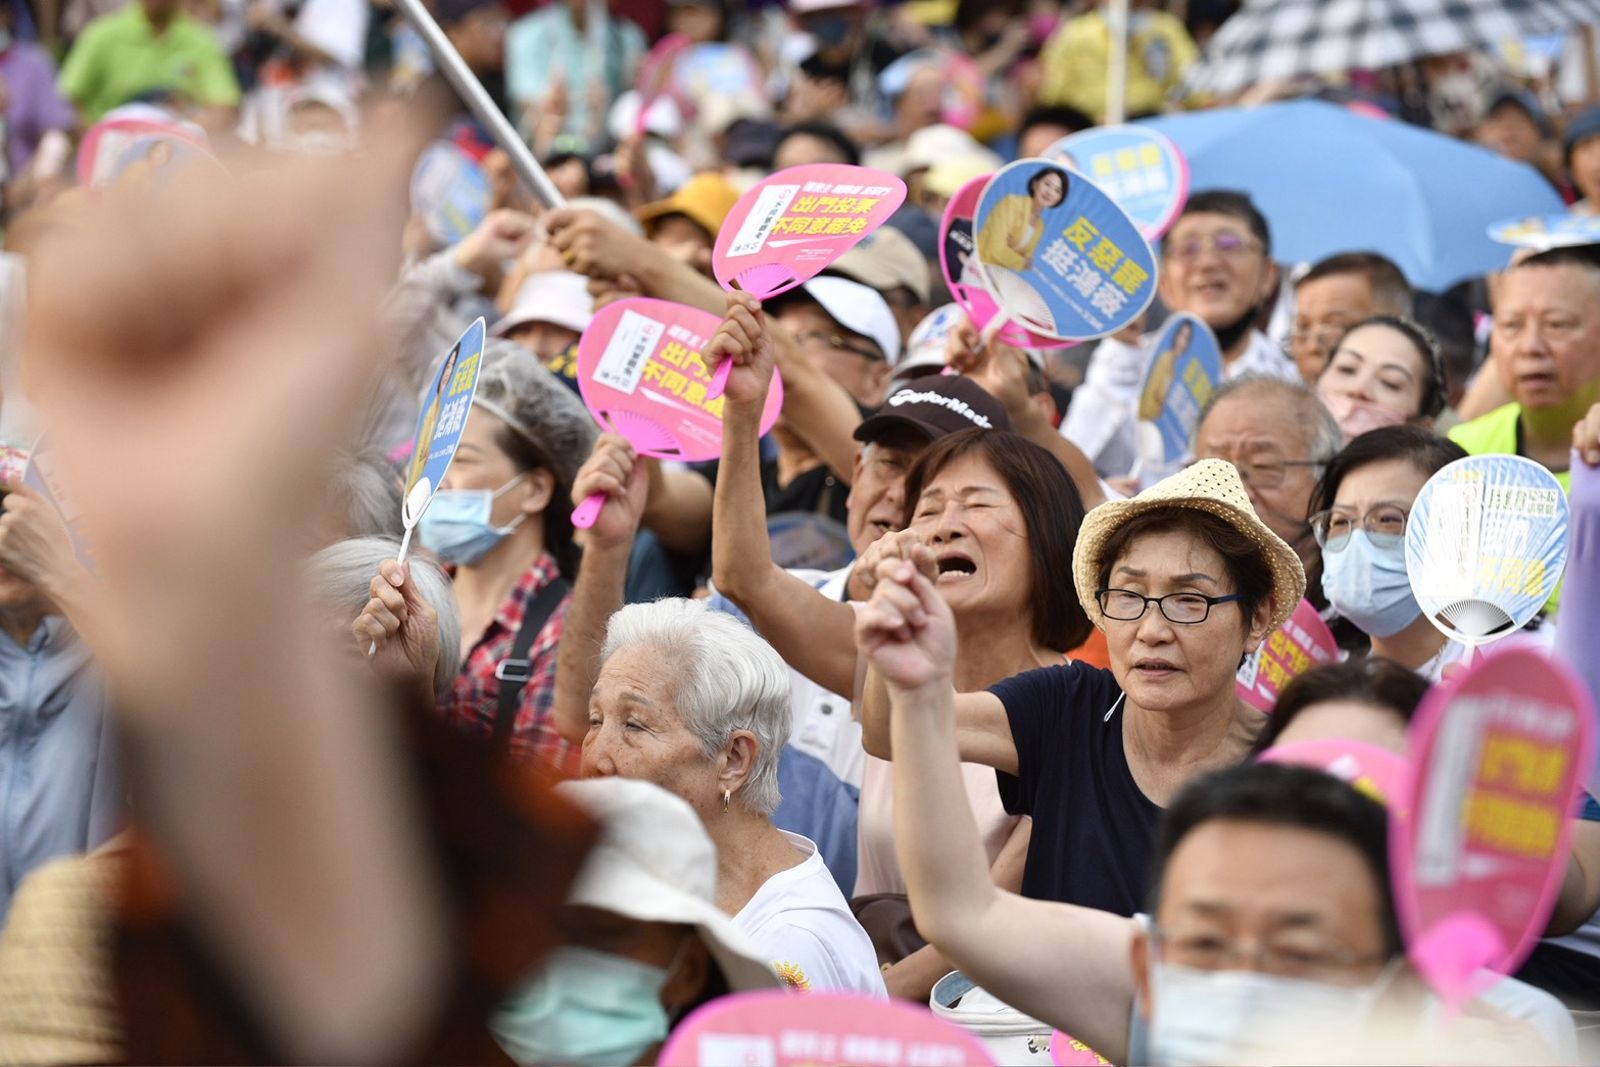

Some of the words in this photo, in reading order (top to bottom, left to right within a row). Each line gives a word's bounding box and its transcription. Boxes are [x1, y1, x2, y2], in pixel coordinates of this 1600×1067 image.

[790, 196, 880, 214] 出門投票
[771, 217, 868, 235] 不同意罷免
[1062, 215, 1149, 296] 反惡罷
